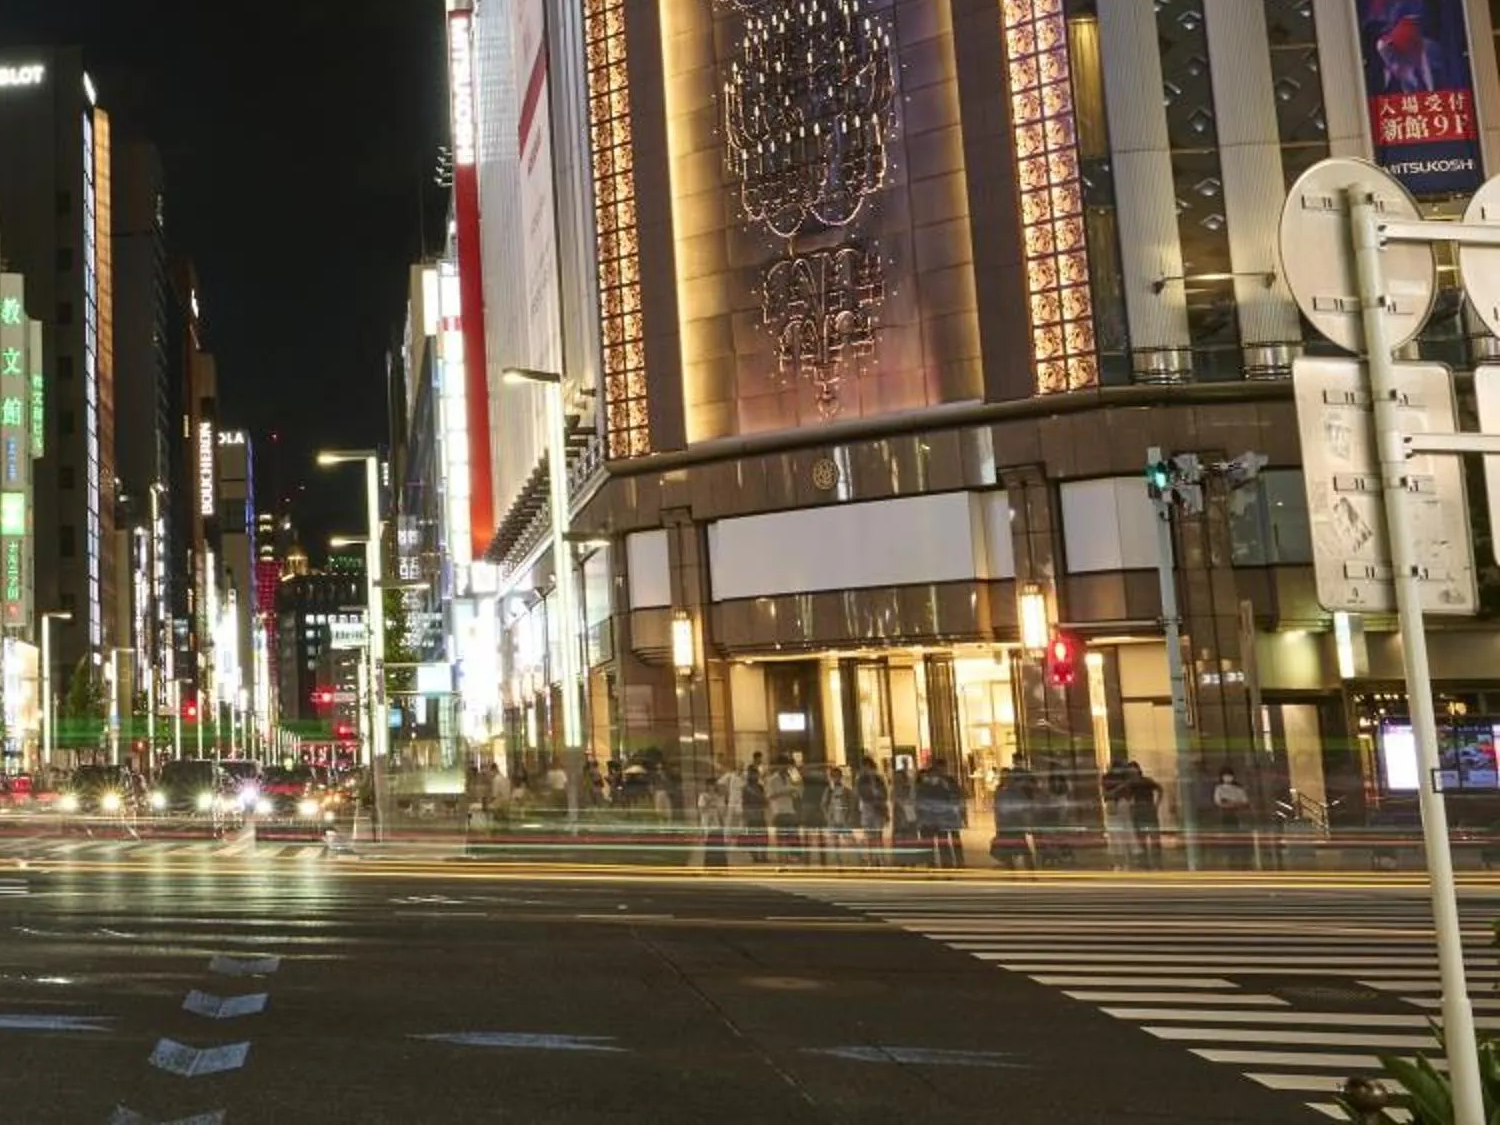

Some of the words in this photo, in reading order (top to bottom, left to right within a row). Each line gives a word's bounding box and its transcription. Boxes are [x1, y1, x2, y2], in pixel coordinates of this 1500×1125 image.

[1, 297, 21, 426] 教文館
[199, 422, 213, 515] BOUCHERON
